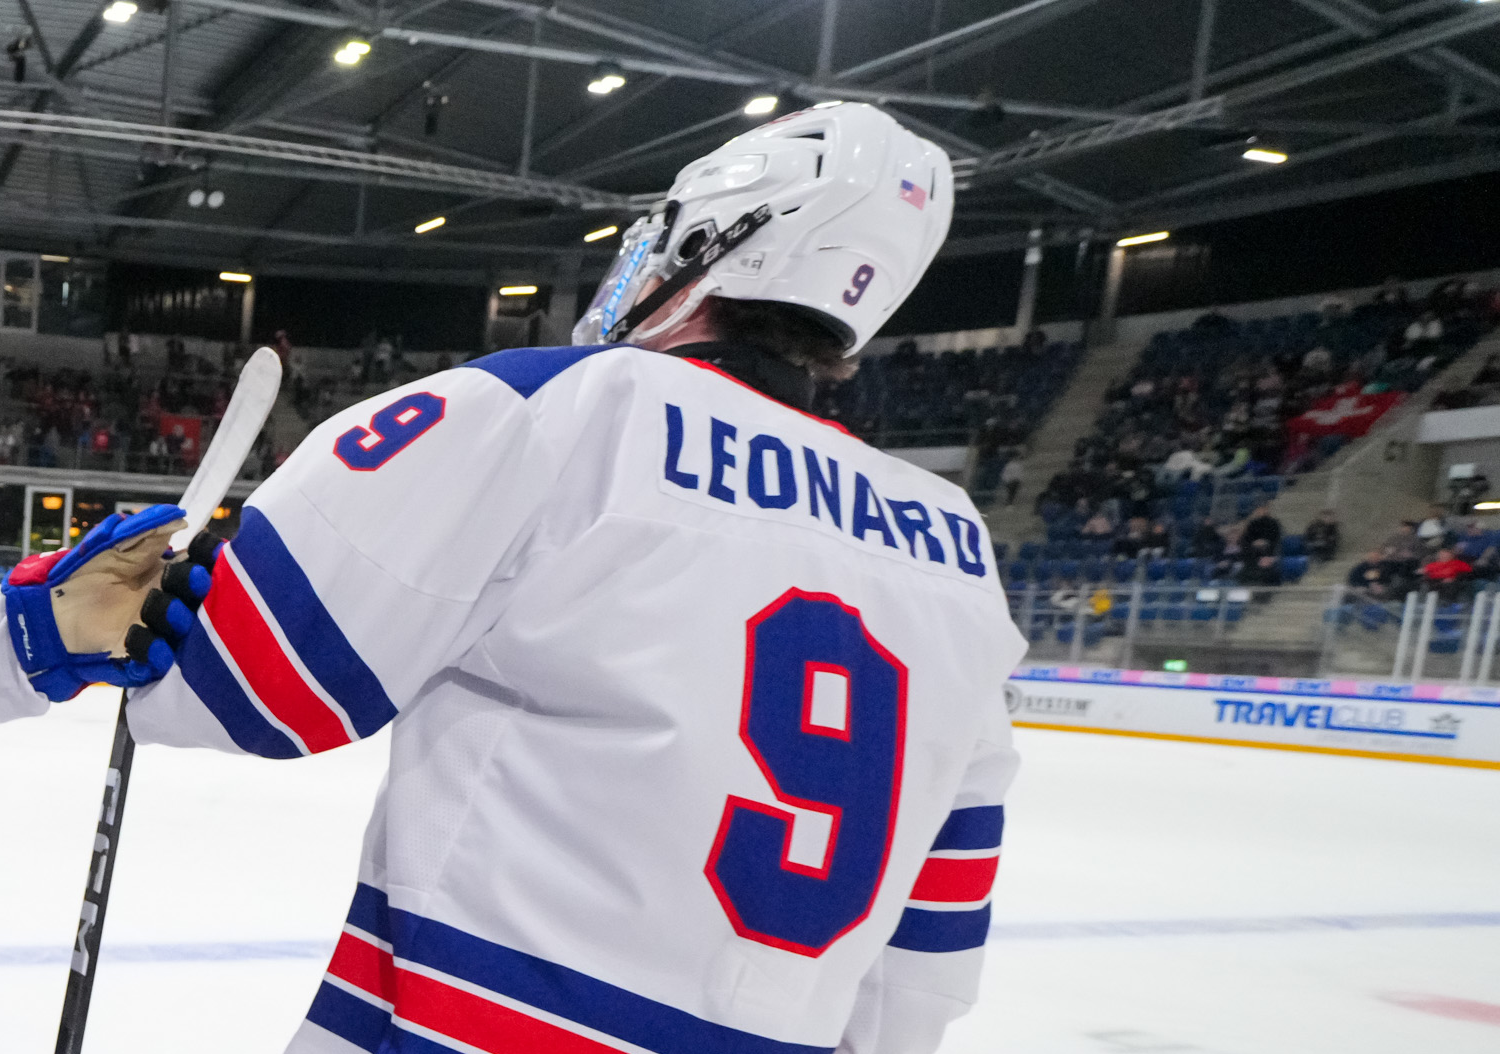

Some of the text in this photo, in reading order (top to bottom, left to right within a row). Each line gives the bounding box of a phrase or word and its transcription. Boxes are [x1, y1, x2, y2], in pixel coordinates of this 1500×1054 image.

[842, 263, 875, 307] 9
[332, 391, 448, 472] 9
[663, 402, 988, 578] LEONARD
[704, 586, 909, 959] 9
